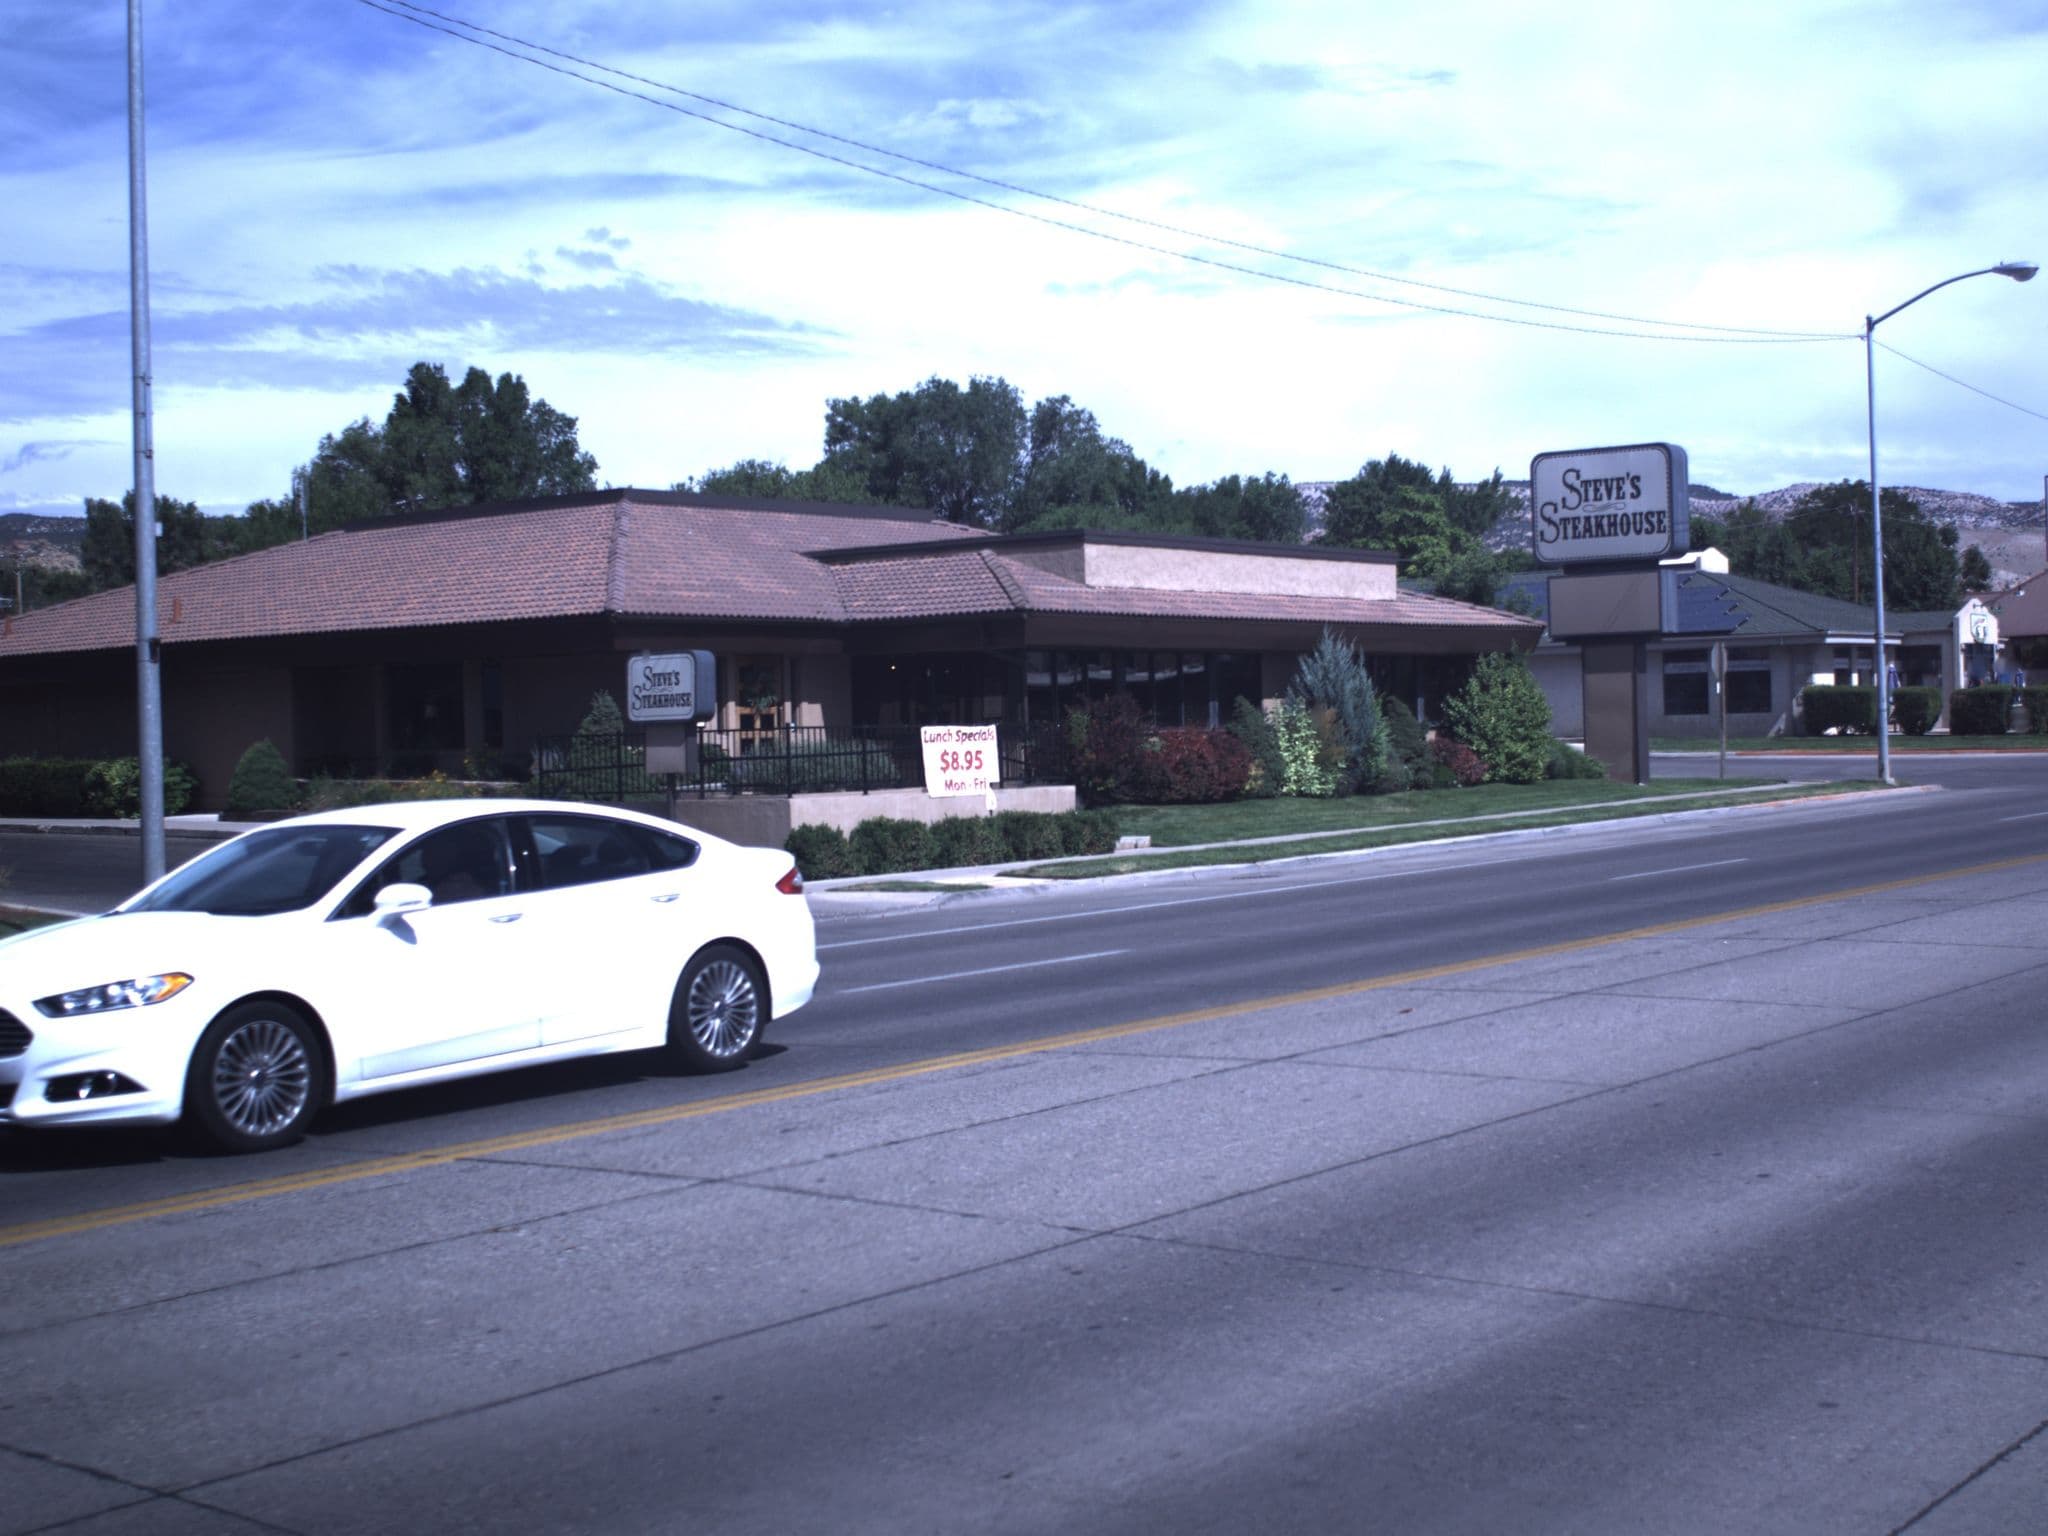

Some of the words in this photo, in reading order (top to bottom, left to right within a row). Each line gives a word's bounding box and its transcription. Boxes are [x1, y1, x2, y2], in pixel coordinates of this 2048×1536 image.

[1561, 468, 1641, 510] STEVE'S
[1540, 502, 1666, 544] STEAKHOUSE
[642, 665, 680, 691] STEVE'S
[632, 685, 691, 711] STEAKHOUSE
[923, 729, 953, 743] Lunch
[955, 728, 994, 744] Specials
[940, 749, 983, 774] $8.95
[944, 779, 966, 791] Mon
[974, 777, 987, 791] Fri
